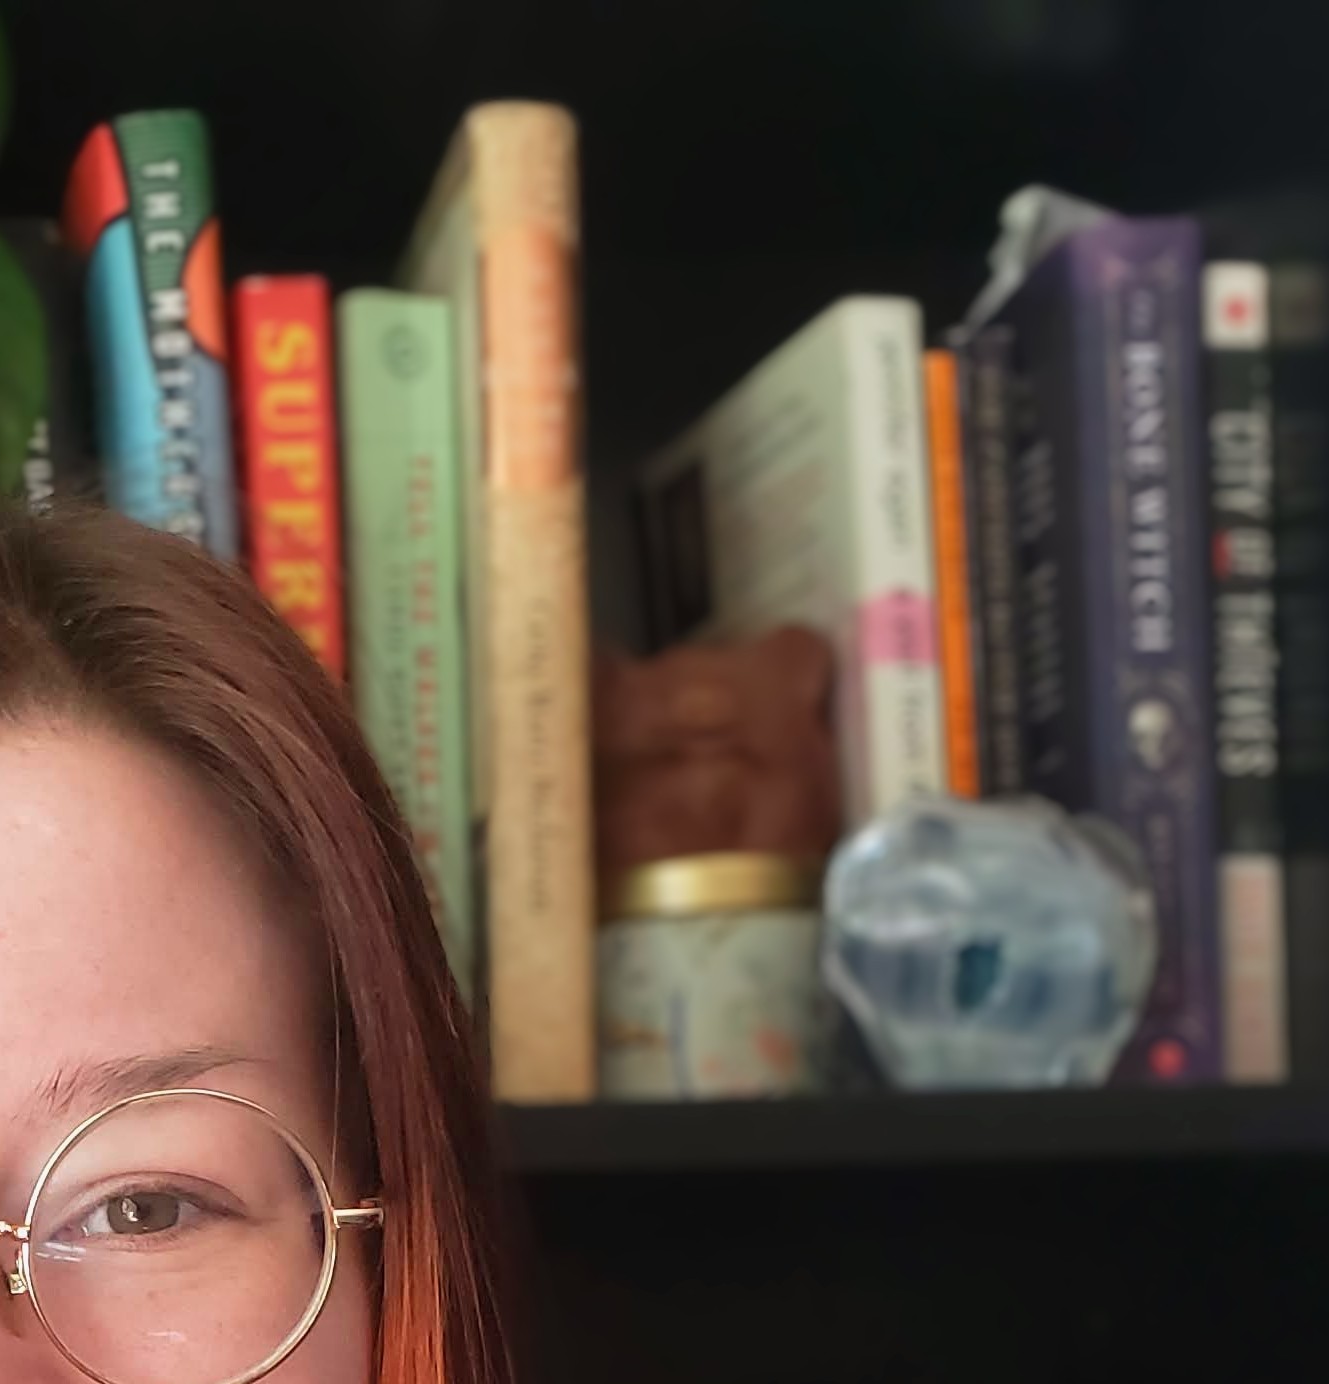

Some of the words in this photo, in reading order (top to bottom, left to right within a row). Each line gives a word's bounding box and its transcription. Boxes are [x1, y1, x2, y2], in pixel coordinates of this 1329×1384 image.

[140, 159, 186, 253] THE
[1122, 340, 1165, 478] BONE
[1209, 409, 1271, 515] CITY
[1130, 488, 1171, 652] WITCH
[1215, 592, 1280, 776] THIEVES
